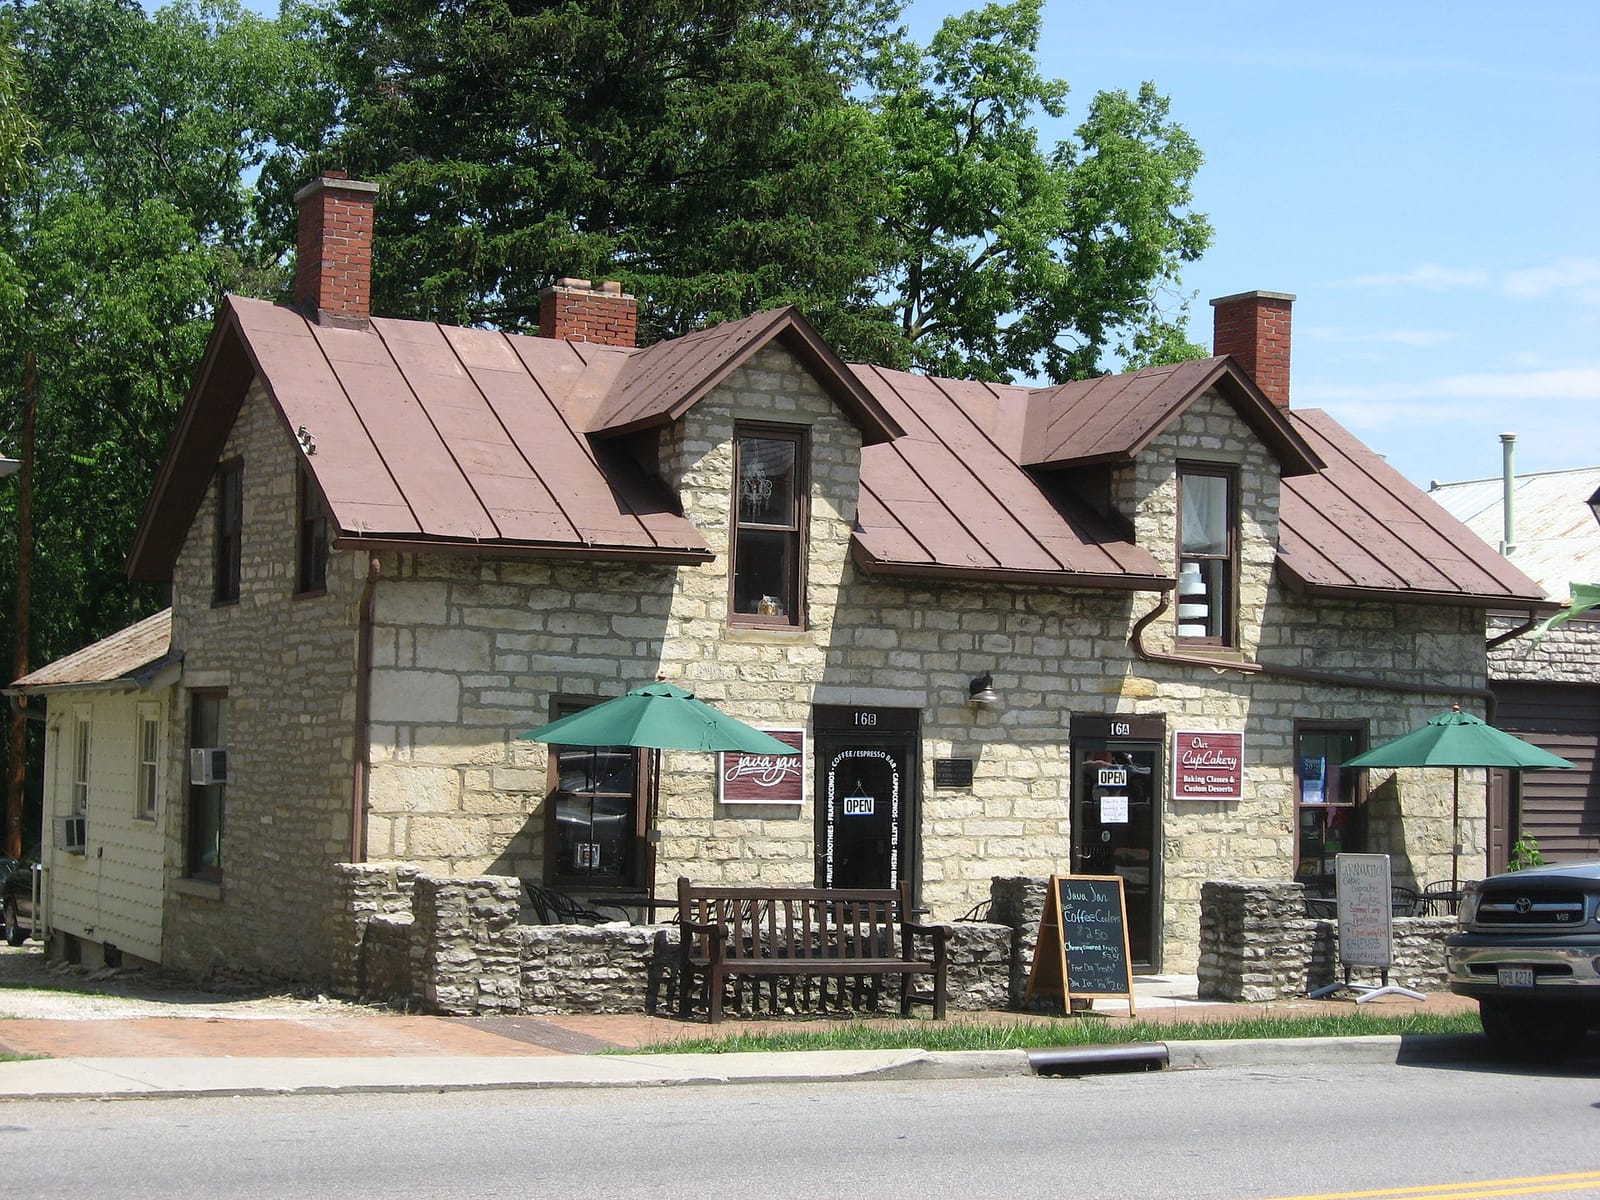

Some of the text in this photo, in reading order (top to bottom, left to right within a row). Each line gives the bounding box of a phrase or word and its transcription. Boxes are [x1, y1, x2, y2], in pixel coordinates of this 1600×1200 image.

[1110, 723, 1130, 735] 16A
[1191, 737, 1208, 749] Our
[1182, 750, 1237, 770] CupCakery
[1100, 771, 1125, 784] OPEN
[1183, 775, 1206, 784] Baking
[1206, 775, 1228, 783] Classes
[1184, 784, 1206, 792] Custom
[827, 772, 835, 821] FRAPPUCCINOS
[891, 773, 899, 818] CAPPUCCINOS
[846, 799, 872, 813] OPEN
[890, 849, 898, 870] FRESH
[1064, 909, 1095, 923] Coffee
